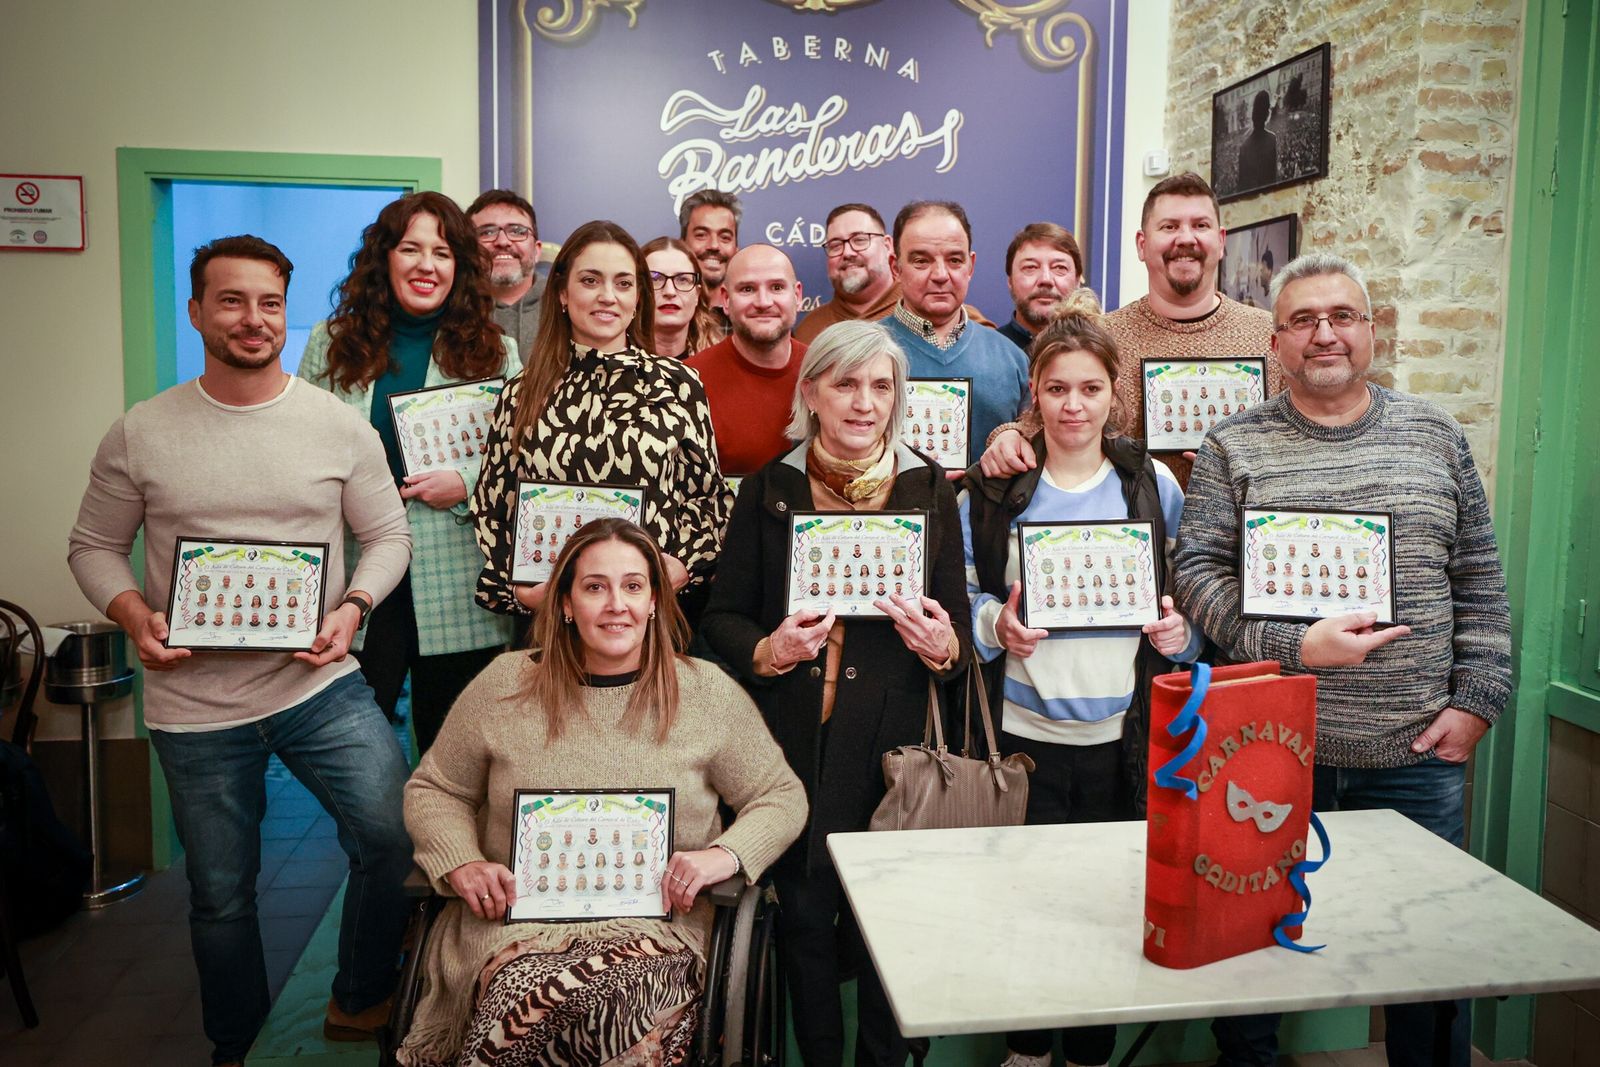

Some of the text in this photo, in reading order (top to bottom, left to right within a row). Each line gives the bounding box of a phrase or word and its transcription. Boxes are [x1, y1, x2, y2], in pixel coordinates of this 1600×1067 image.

[707, 35, 919, 82] TABERNA
[658, 95, 963, 222] Banderas
[765, 217, 827, 247] CÁD
[1197, 720, 1312, 792] CARNAVAL
